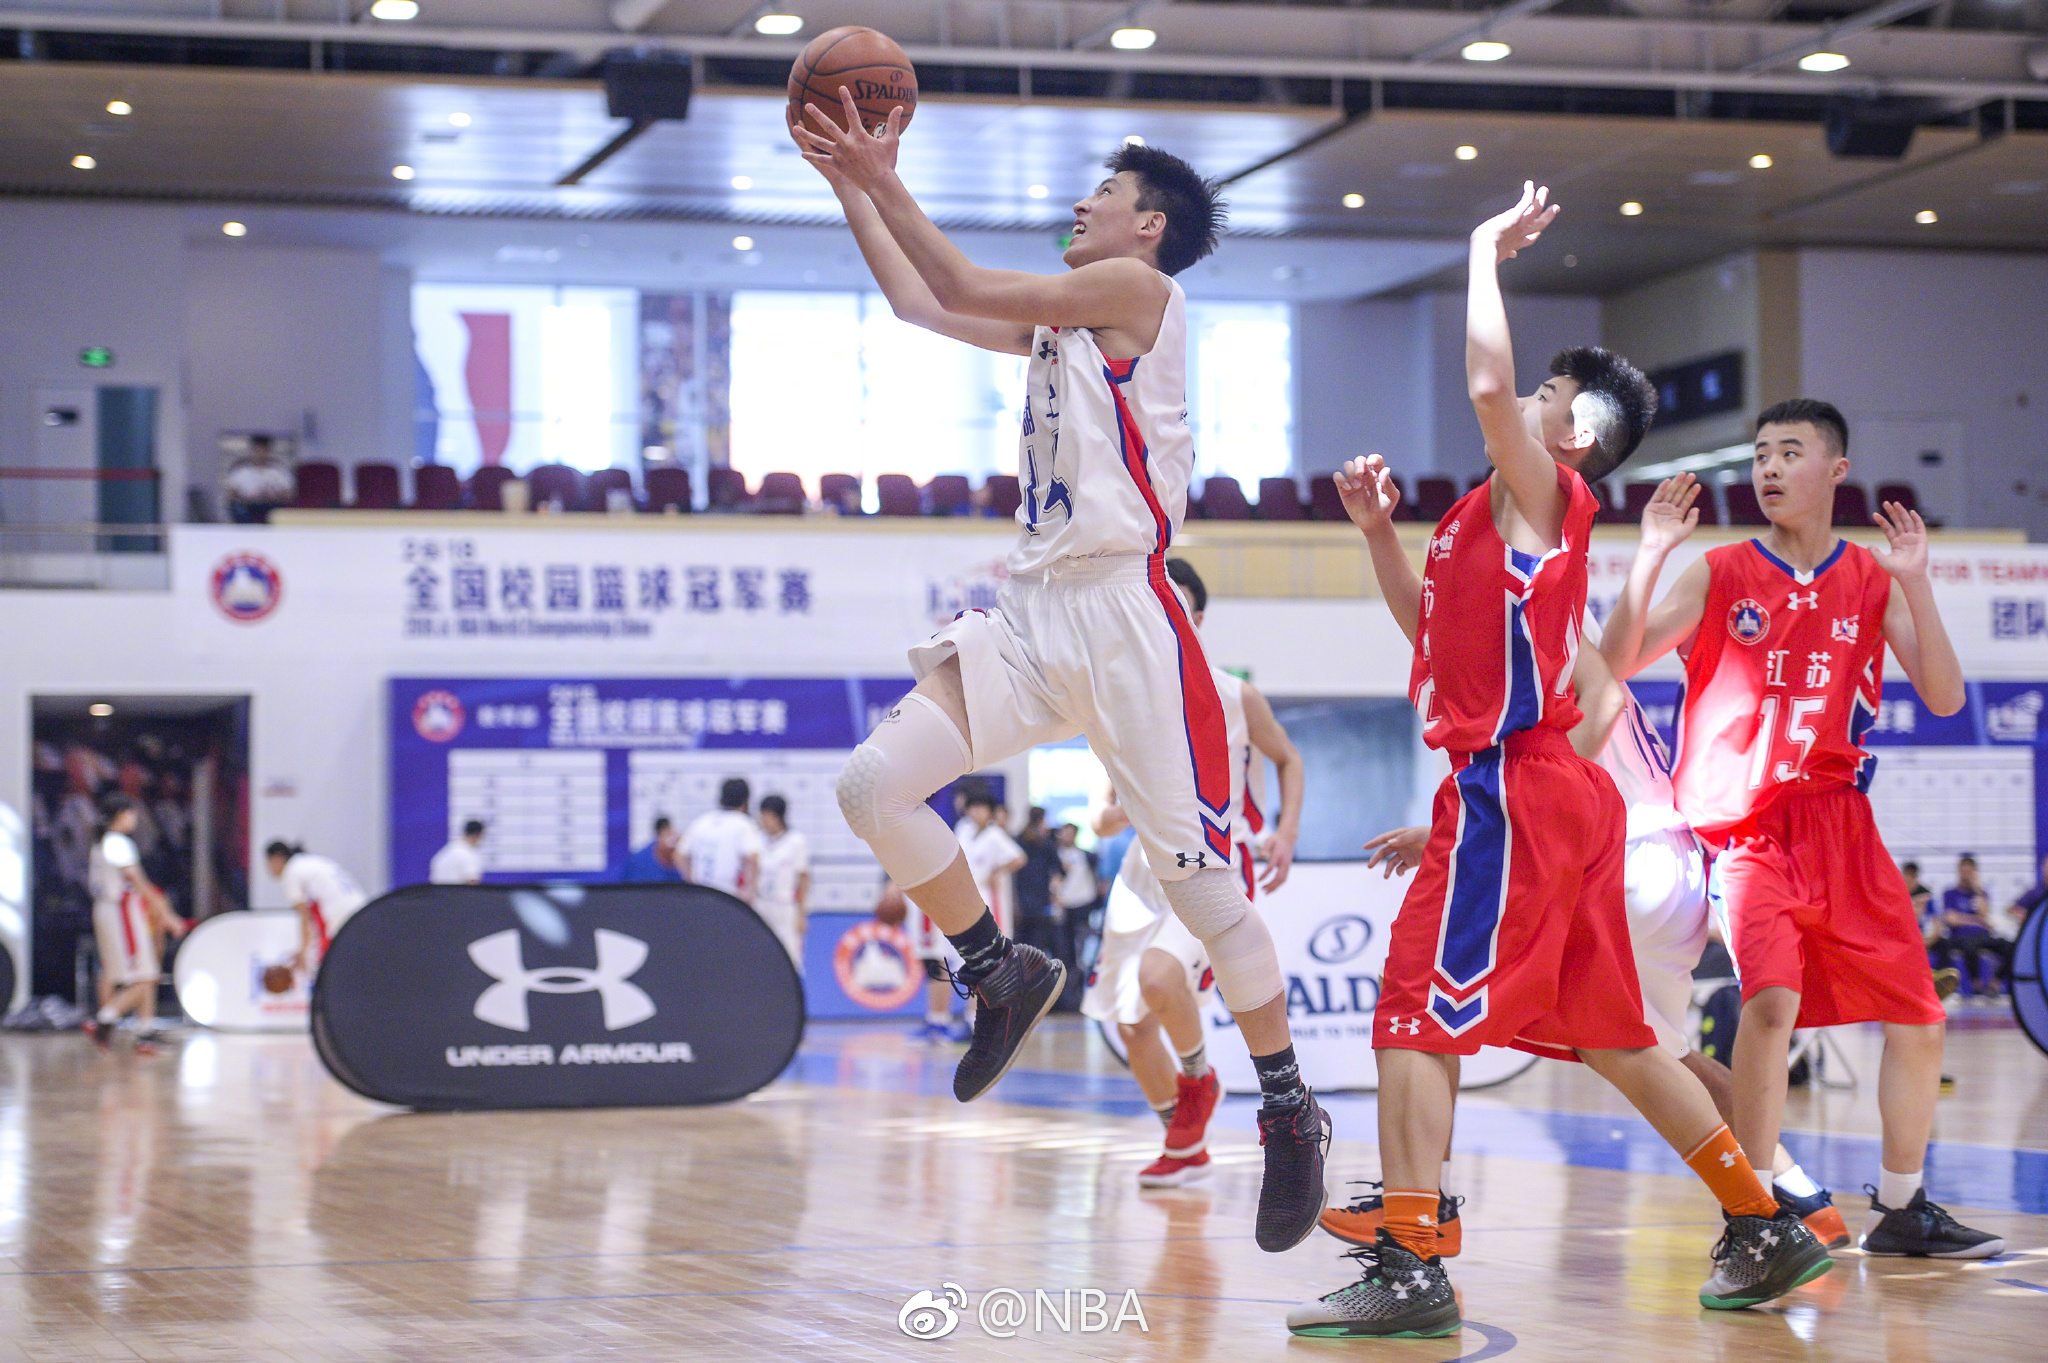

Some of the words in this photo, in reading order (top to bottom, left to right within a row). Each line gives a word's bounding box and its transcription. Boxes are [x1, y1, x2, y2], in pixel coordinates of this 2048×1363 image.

[1767, 650, 1832, 688] 江苏
[1748, 694, 1827, 790] 15
[446, 1045, 555, 1067] UNDER
[558, 1042, 695, 1065] ARMOUR
